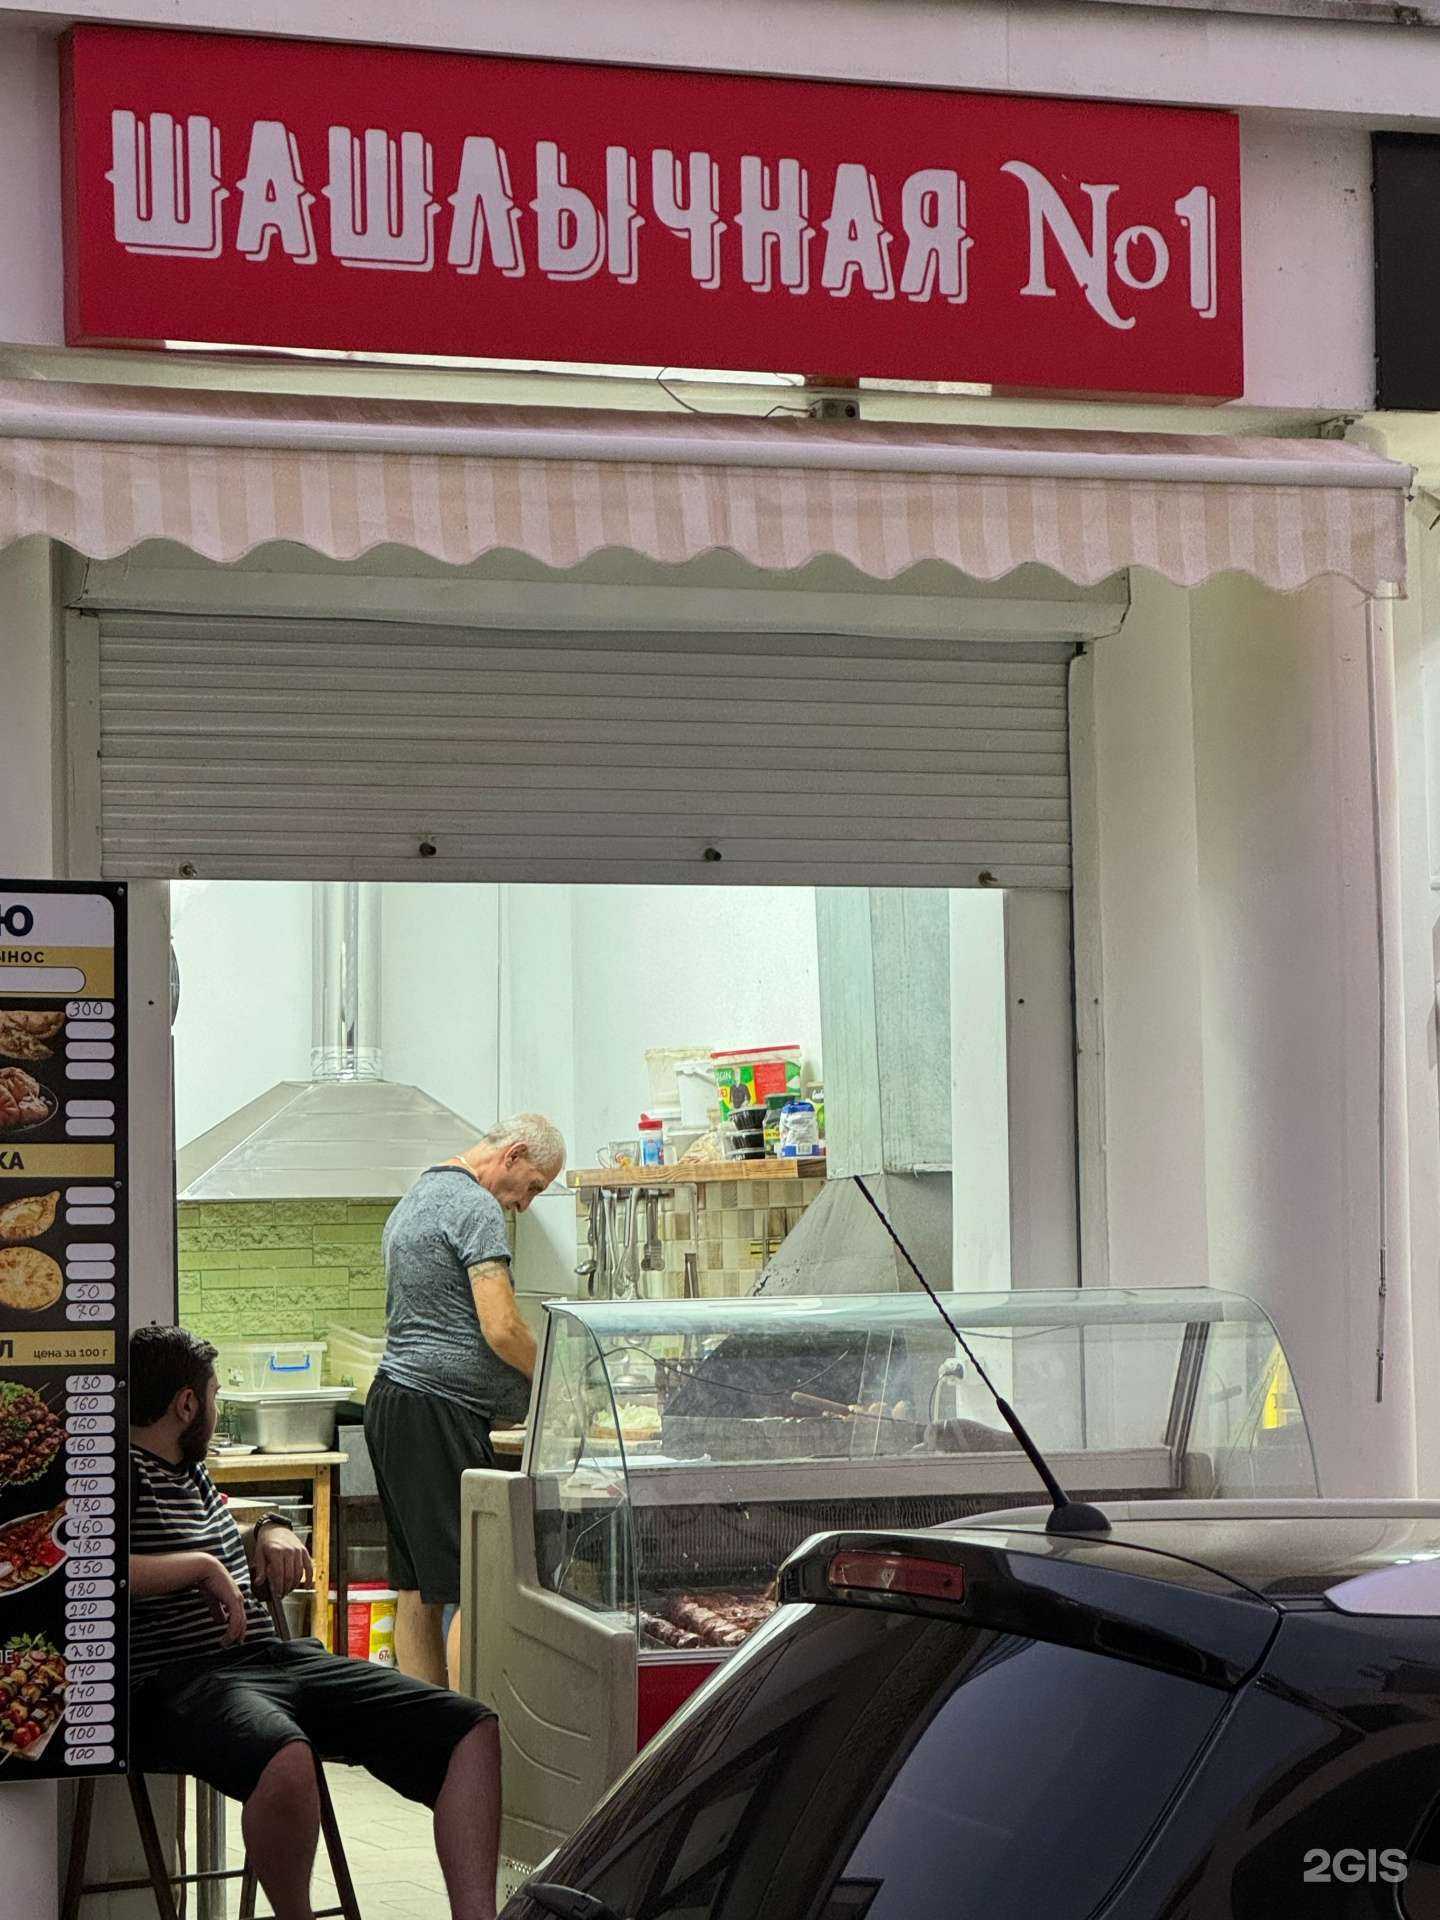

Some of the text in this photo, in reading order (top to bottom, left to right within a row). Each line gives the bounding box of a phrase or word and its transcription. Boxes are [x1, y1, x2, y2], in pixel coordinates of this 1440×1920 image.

[106, 111, 973, 303] ШАШЛЫЧНАЯ
[69, 1001, 103, 1017] 300
[76, 1284, 100, 1299] 50
[33, 1349, 62, 1359] цена
[64, 1348, 77, 1358] за
[79, 1348, 100, 1357] 100
[102, 1348, 109, 1357] г
[72, 1376, 101, 1391] 180
[72, 1396, 99, 1411] 160
[70, 1438, 96, 1451] 160
[71, 1458, 97, 1471] 150
[72, 1479, 98, 1492] 140
[72, 1498, 101, 1512] 480
[72, 1519, 103, 1534] 460
[72, 1560, 103, 1575] 350
[69, 1582, 96, 1597] 180
[69, 1602, 97, 1618] 220
[68, 1623, 95, 1637] 240
[71, 1644, 105, 1657] 280
[70, 1664, 96, 1679] 140
[69, 1686, 95, 1700] 140
[69, 1705, 94, 1721] 100
[69, 1726, 96, 1741] 100
[69, 1748, 96, 1762] 100
